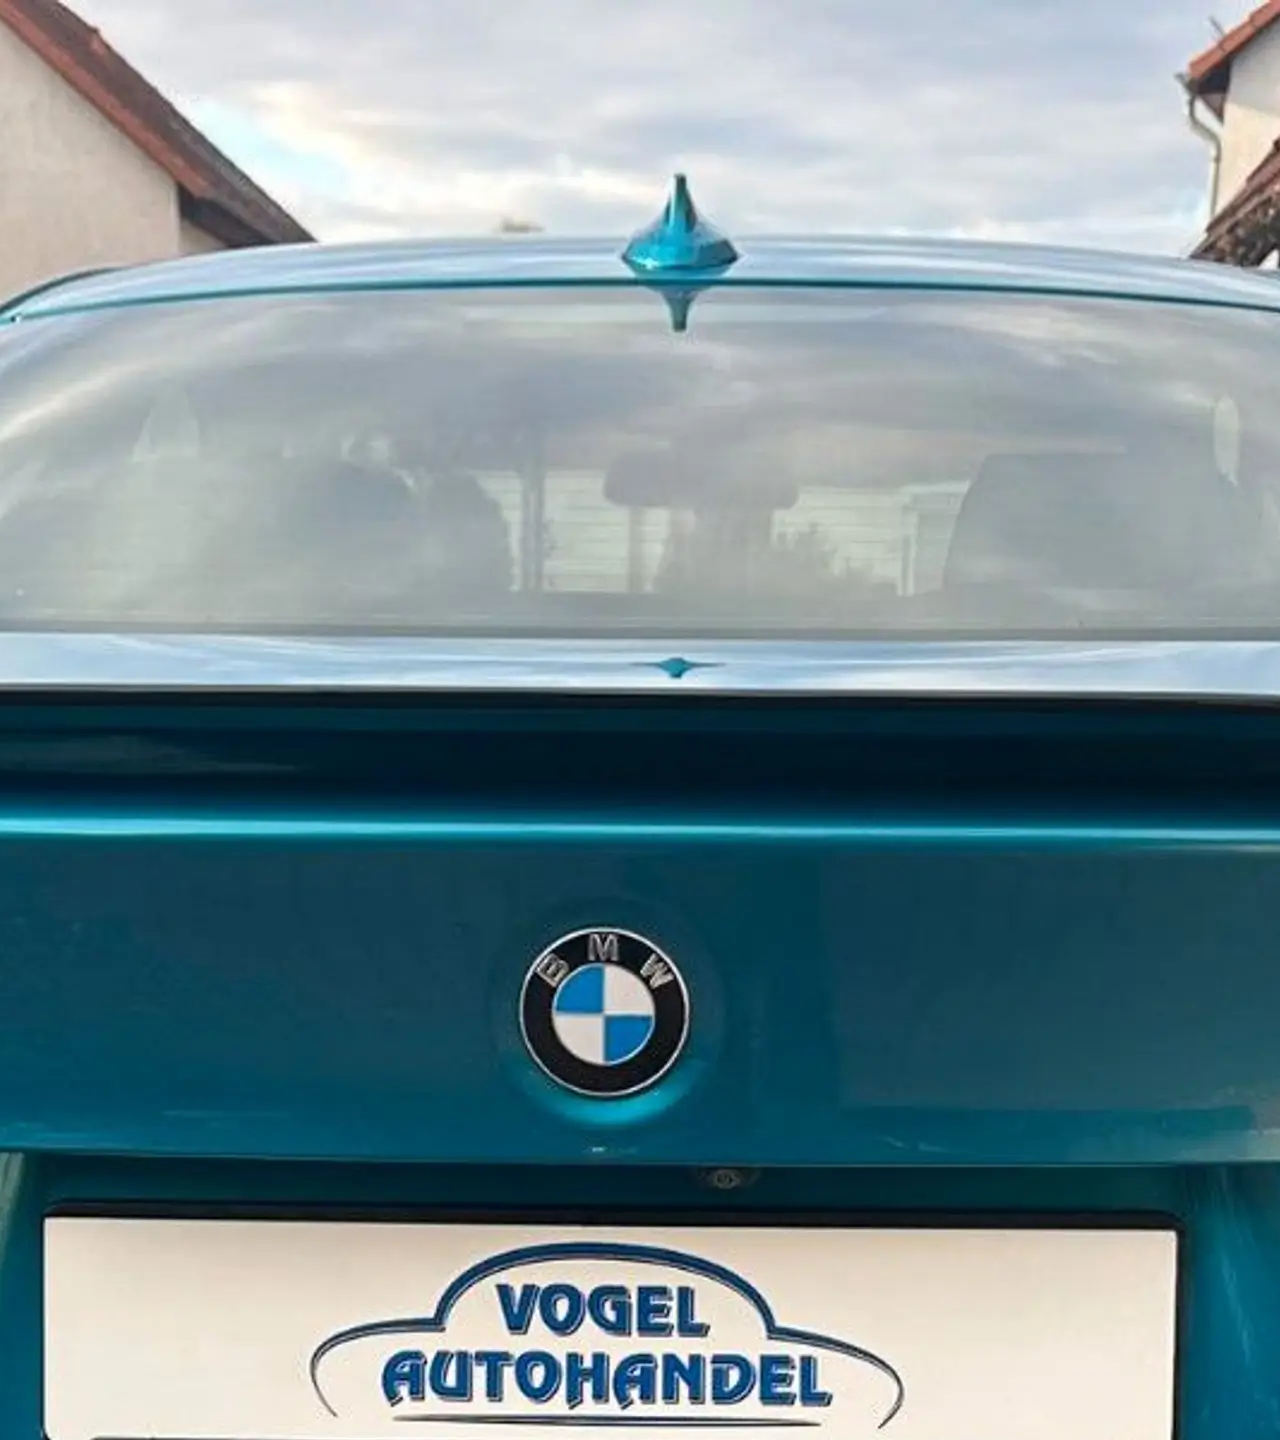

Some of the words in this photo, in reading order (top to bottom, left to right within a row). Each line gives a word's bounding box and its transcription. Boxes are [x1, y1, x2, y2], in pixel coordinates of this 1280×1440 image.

[536, 933, 675, 989] BMW
[495, 1283, 710, 1338] VOGEL
[381, 1350, 834, 1410] AUTOHANDEL
